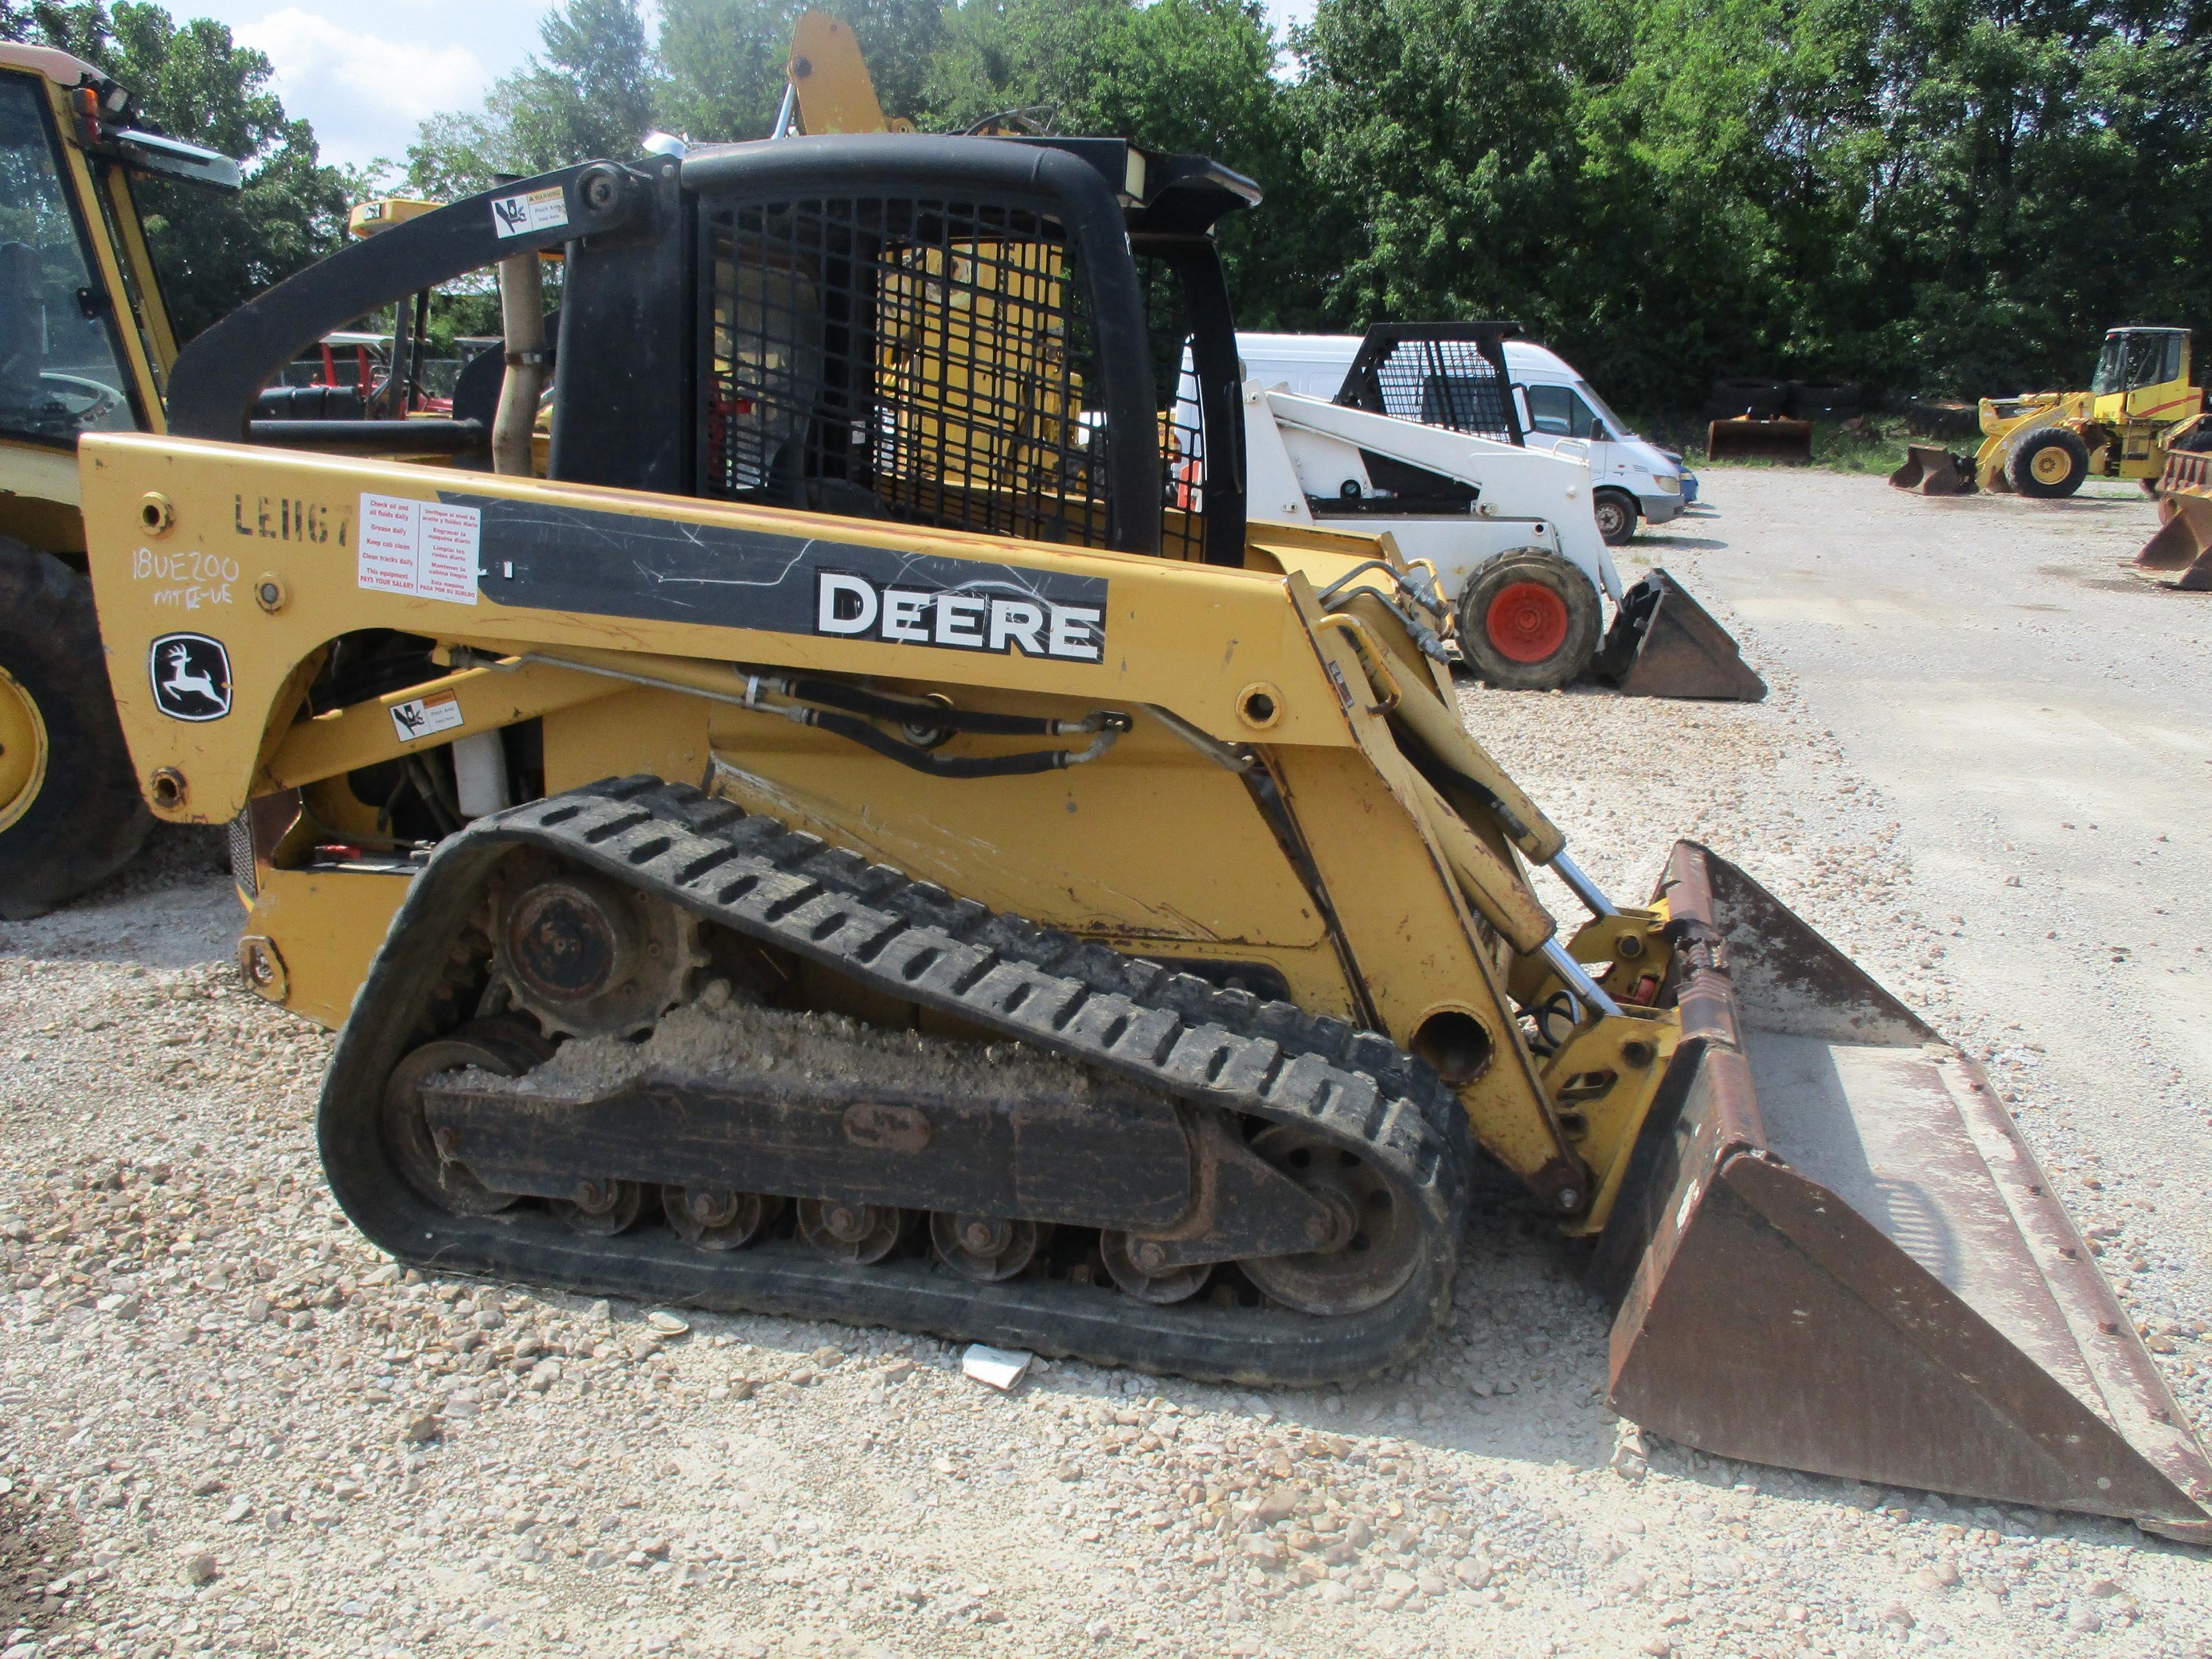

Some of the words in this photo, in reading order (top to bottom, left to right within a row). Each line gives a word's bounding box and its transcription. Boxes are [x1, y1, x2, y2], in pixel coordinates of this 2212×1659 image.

[371, 524, 391, 532] Grease
[393, 527, 406, 536] daily
[366, 539, 381, 547] Keep
[399, 558, 413, 566] daily
[380, 570, 408, 579] equipment
[392, 581, 414, 589] SALARY
[819, 573, 1100, 659] DEERE
